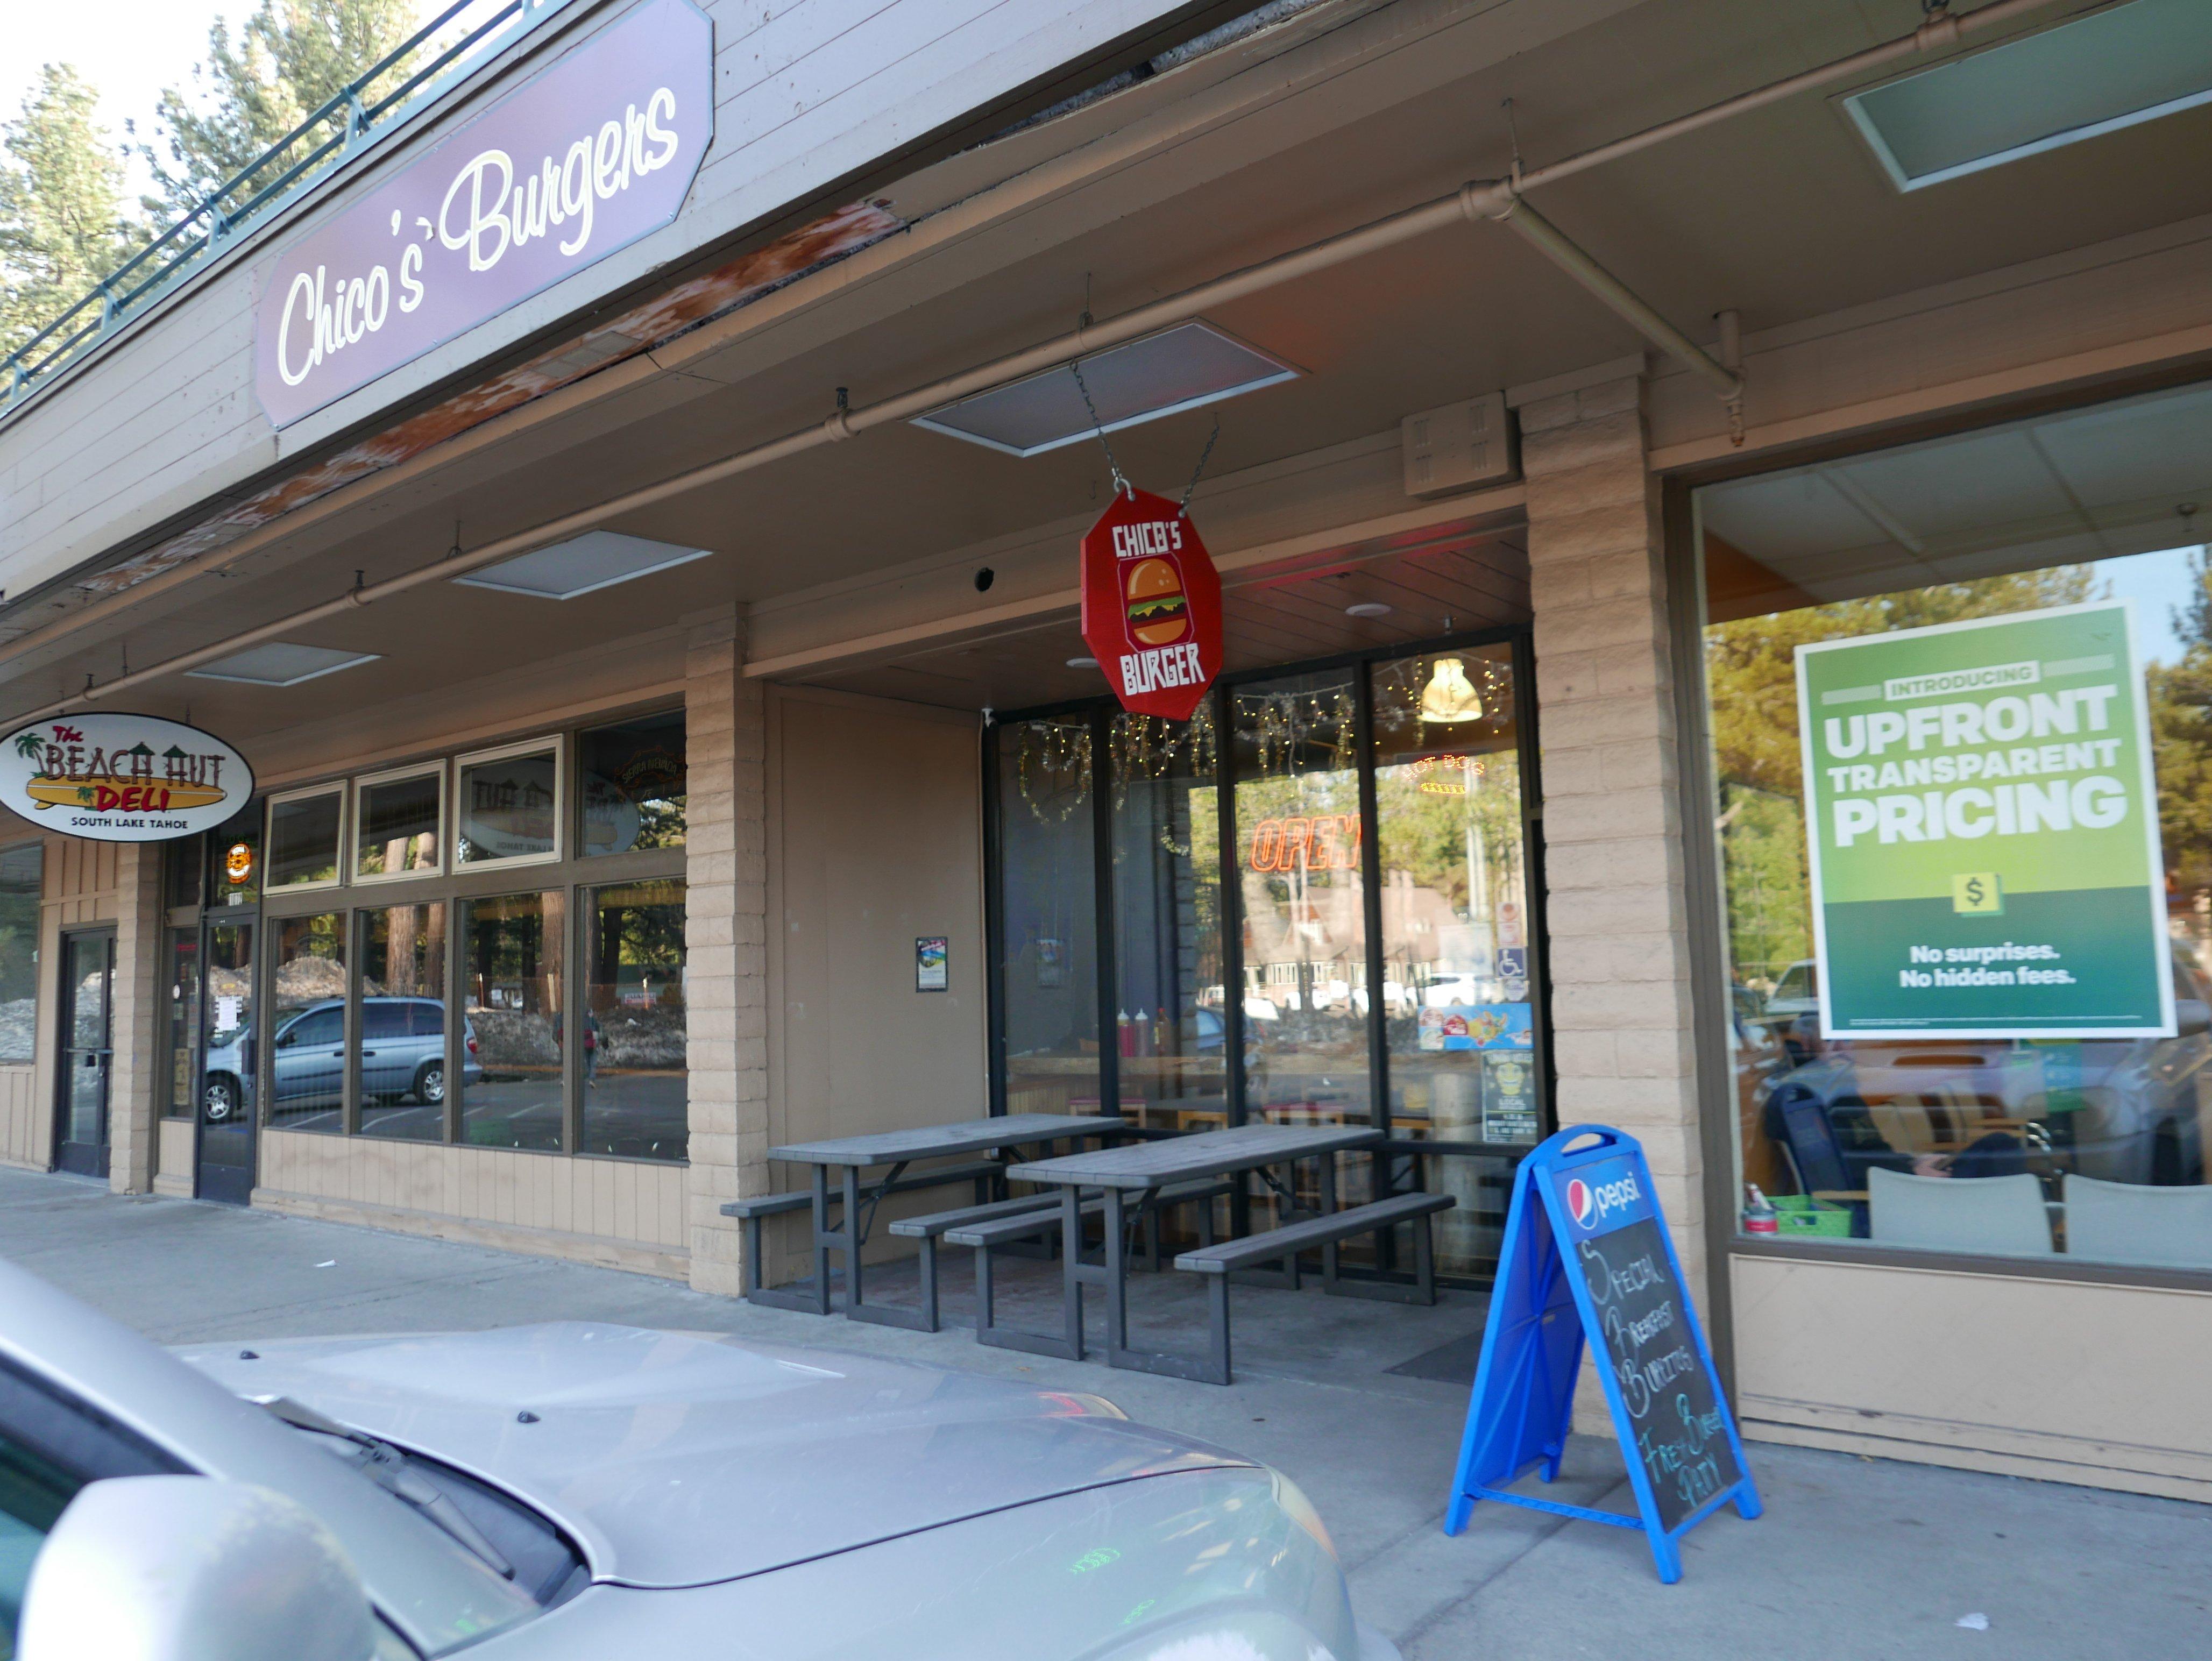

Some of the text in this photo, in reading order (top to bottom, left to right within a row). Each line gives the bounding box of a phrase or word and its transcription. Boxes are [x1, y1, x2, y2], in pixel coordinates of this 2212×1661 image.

[278, 87, 679, 386] Chico's Burgers
[1112, 521, 1182, 557] CHICO'S
[1120, 643, 1205, 695] BURGER
[1890, 665, 2034, 697] INTRODUCING
[52, 726, 84, 742] The
[1824, 685, 2118, 759] UPFRONT
[45, 741, 226, 787] BEACH HUT
[1402, 755, 1485, 782] HOT DOG
[1827, 738, 2122, 793] TRANSPARENT
[96, 785, 170, 813] DELI
[1833, 775, 2128, 847] PRICING
[72, 817, 188, 829] SOUTH LAKE TAHOE
[1251, 814, 1362, 872] OPEN
[1910, 941, 2061, 965] No surprises.
[1899, 966, 2076, 988] No hidden fees.
[1595, 1171, 1640, 1218] pepsi
